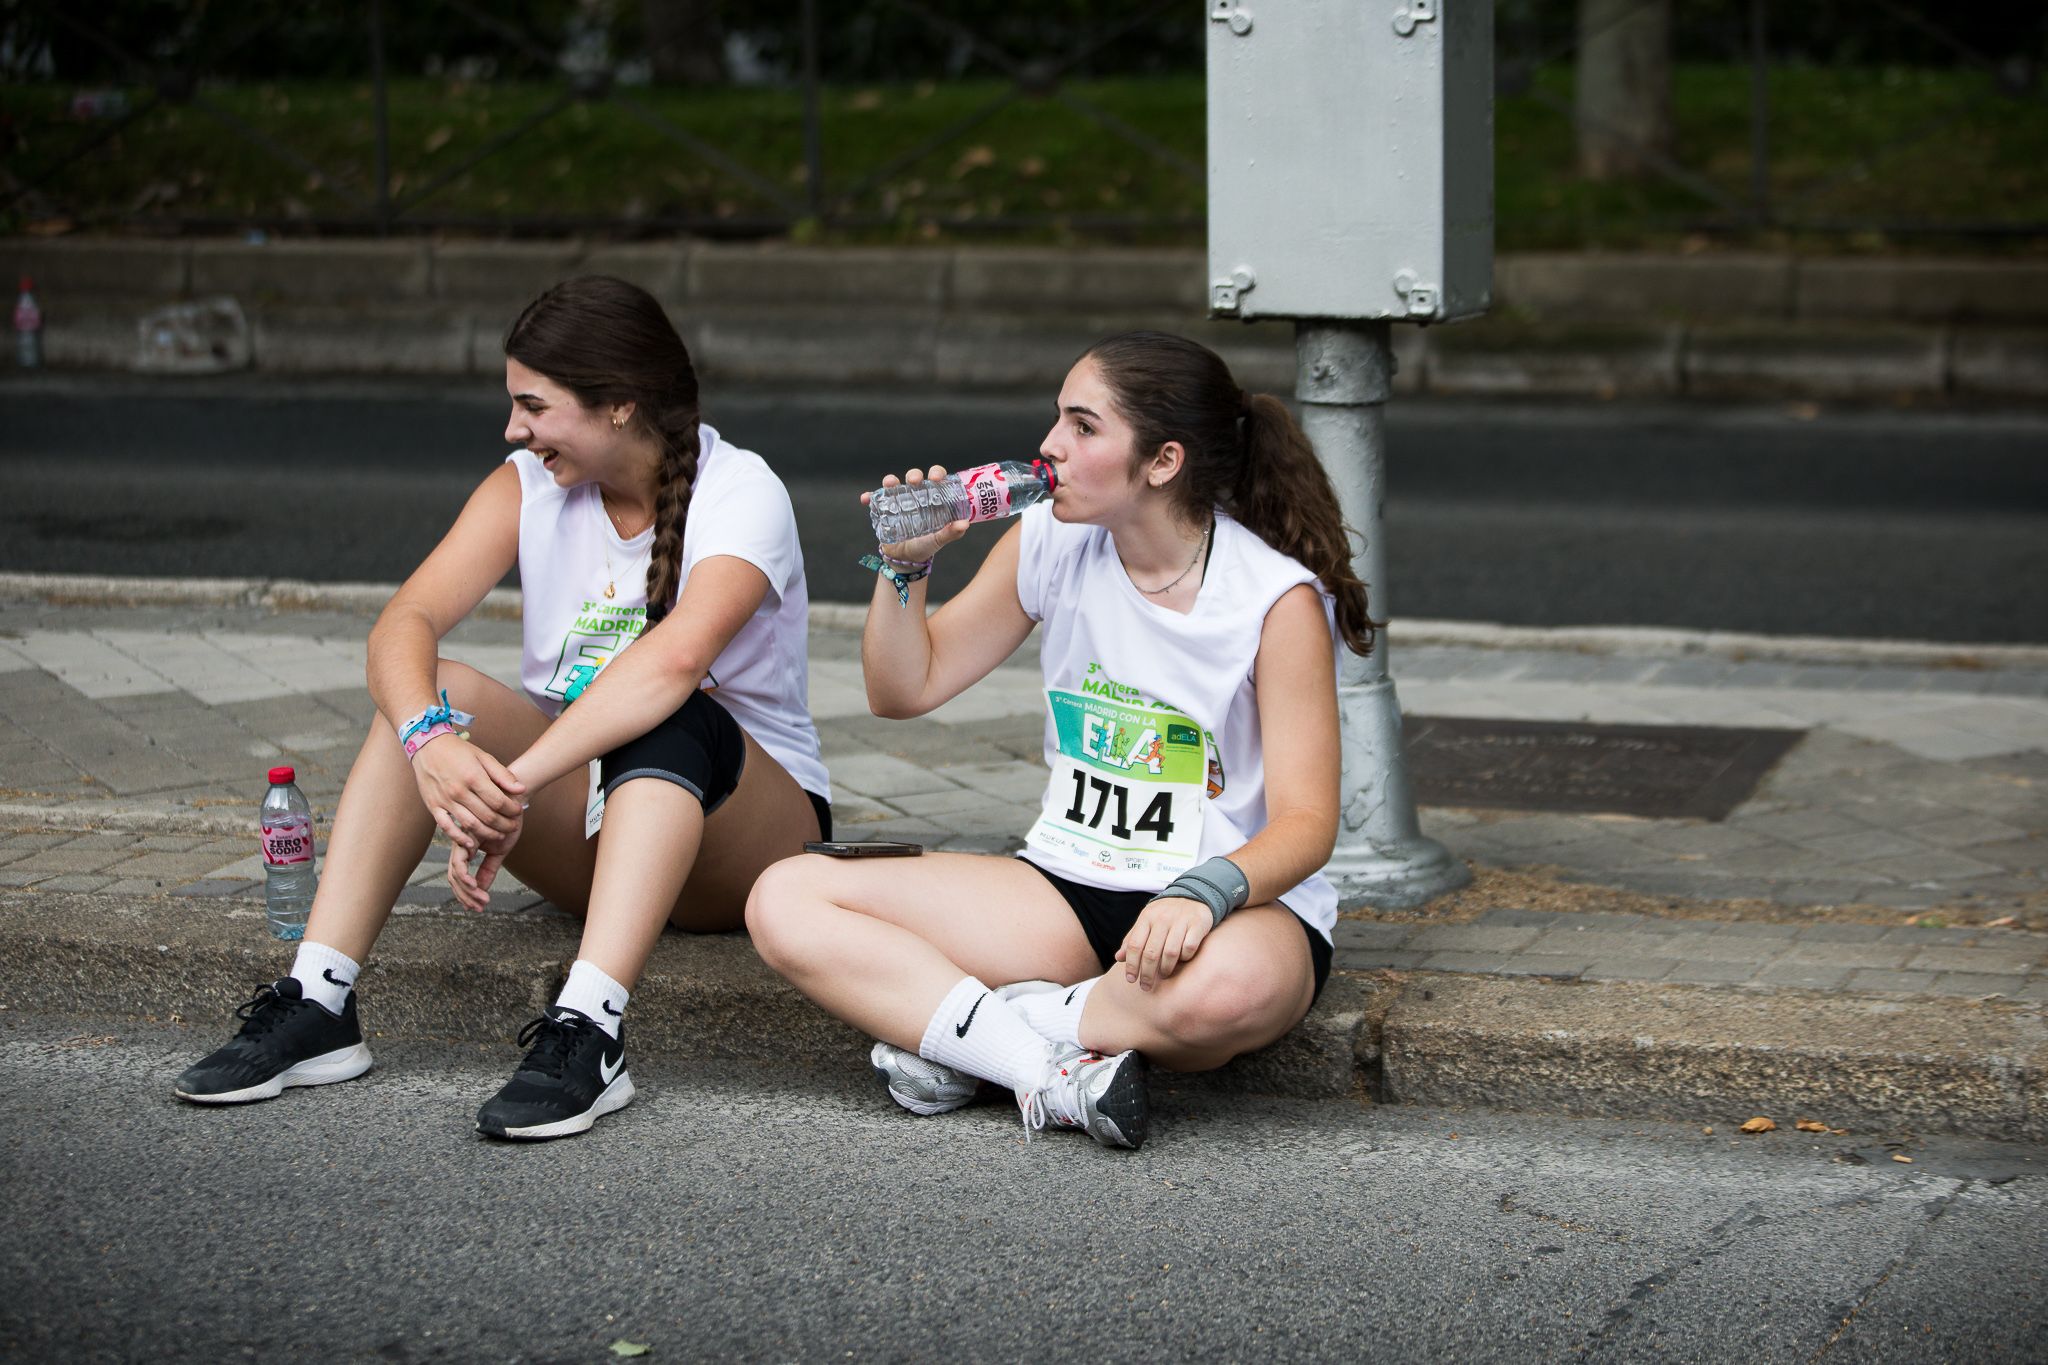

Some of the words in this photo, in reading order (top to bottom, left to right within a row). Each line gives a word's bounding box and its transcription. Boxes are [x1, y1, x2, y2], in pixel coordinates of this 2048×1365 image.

[977, 482, 990, 515] SODIO
[984, 480, 998, 513] ZERO
[574, 616, 643, 634] MADRID
[1081, 678, 1145, 707] MAD
[1063, 698, 1083, 709] Carrera
[1084, 702, 1118, 719] MADRID
[1120, 712, 1140, 725] CON
[1142, 716, 1157, 728] LA
[1082, 712, 1164, 775] ELA
[1171, 732, 1197, 743] adELA
[1065, 768, 1175, 842] 1714
[269, 838, 301, 848] ZERO
[270, 846, 302, 855] SODIO
